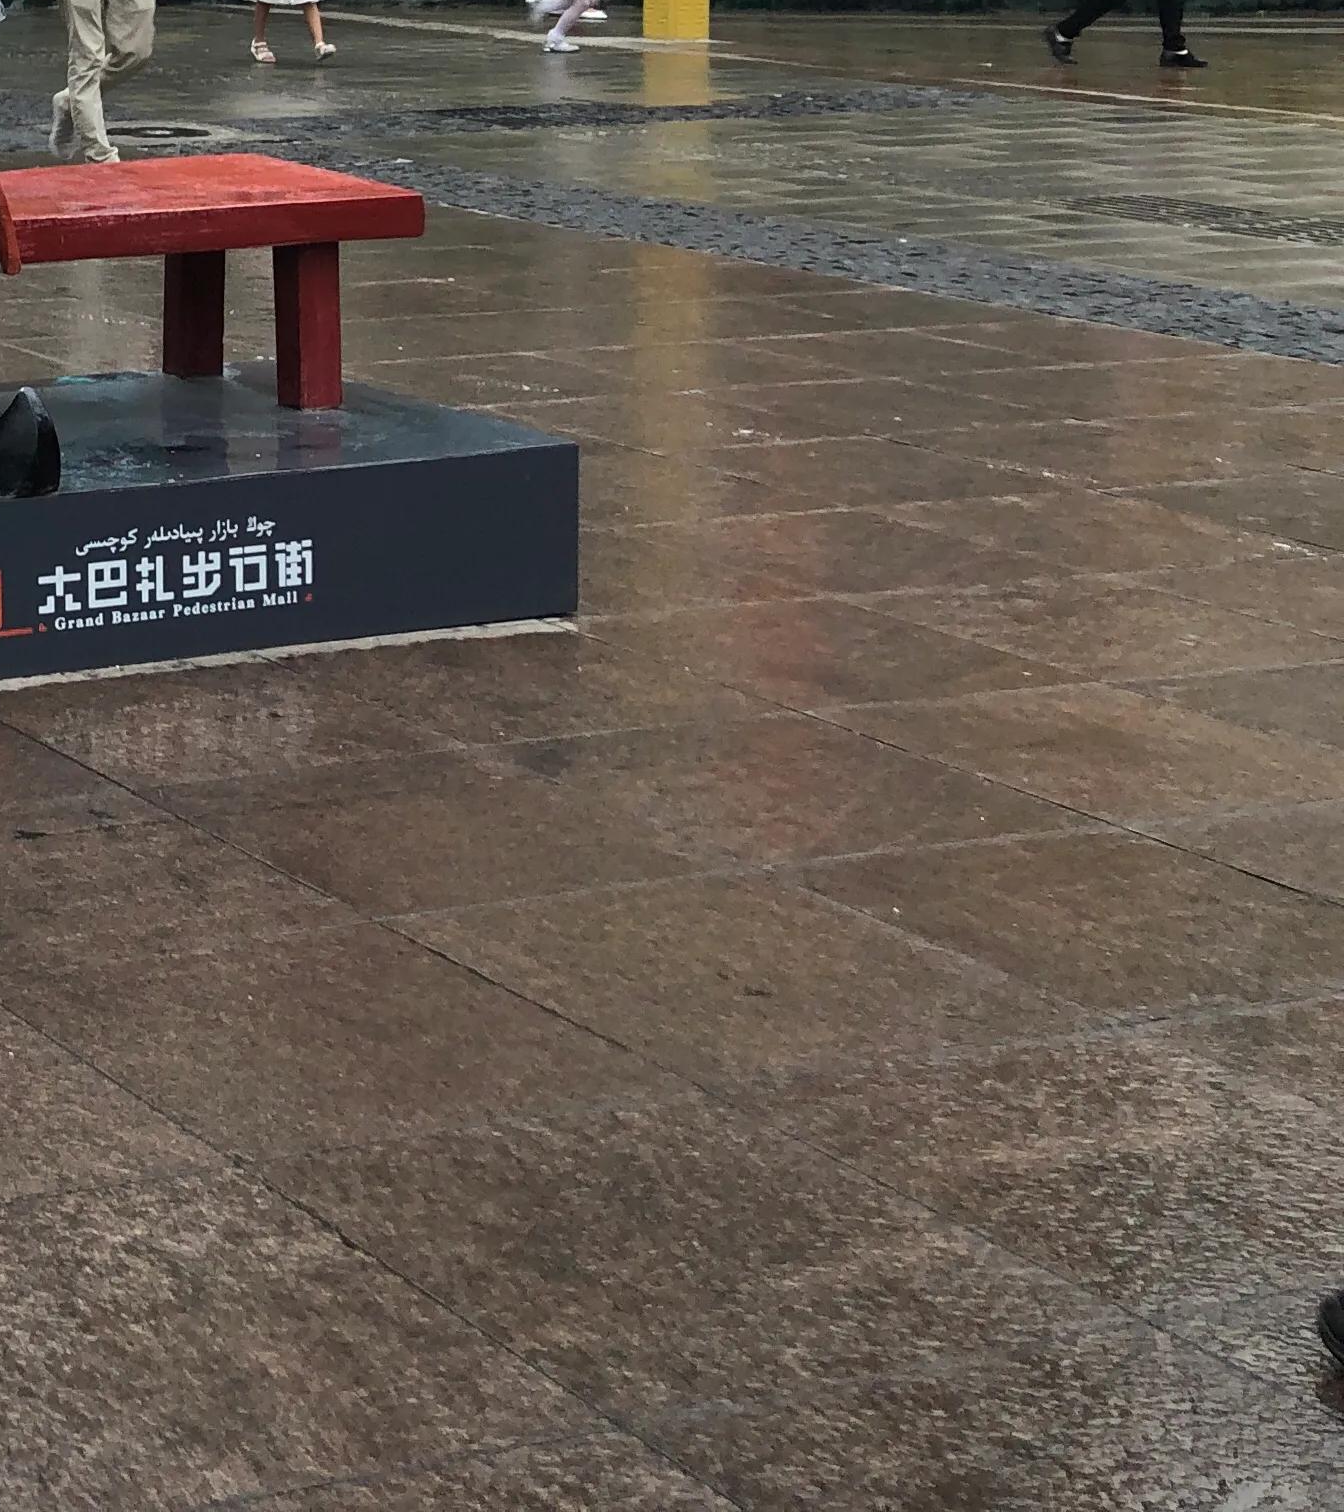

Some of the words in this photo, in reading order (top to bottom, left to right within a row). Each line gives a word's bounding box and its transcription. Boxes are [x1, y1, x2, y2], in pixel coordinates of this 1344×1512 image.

[38, 539, 313, 615] 大巴扎步行街
[54, 612, 104, 631] Grand
[111, 607, 166, 625] Bazaar
[172, 596, 256, 617] Pedestrian
[262, 590, 299, 607] Mall
